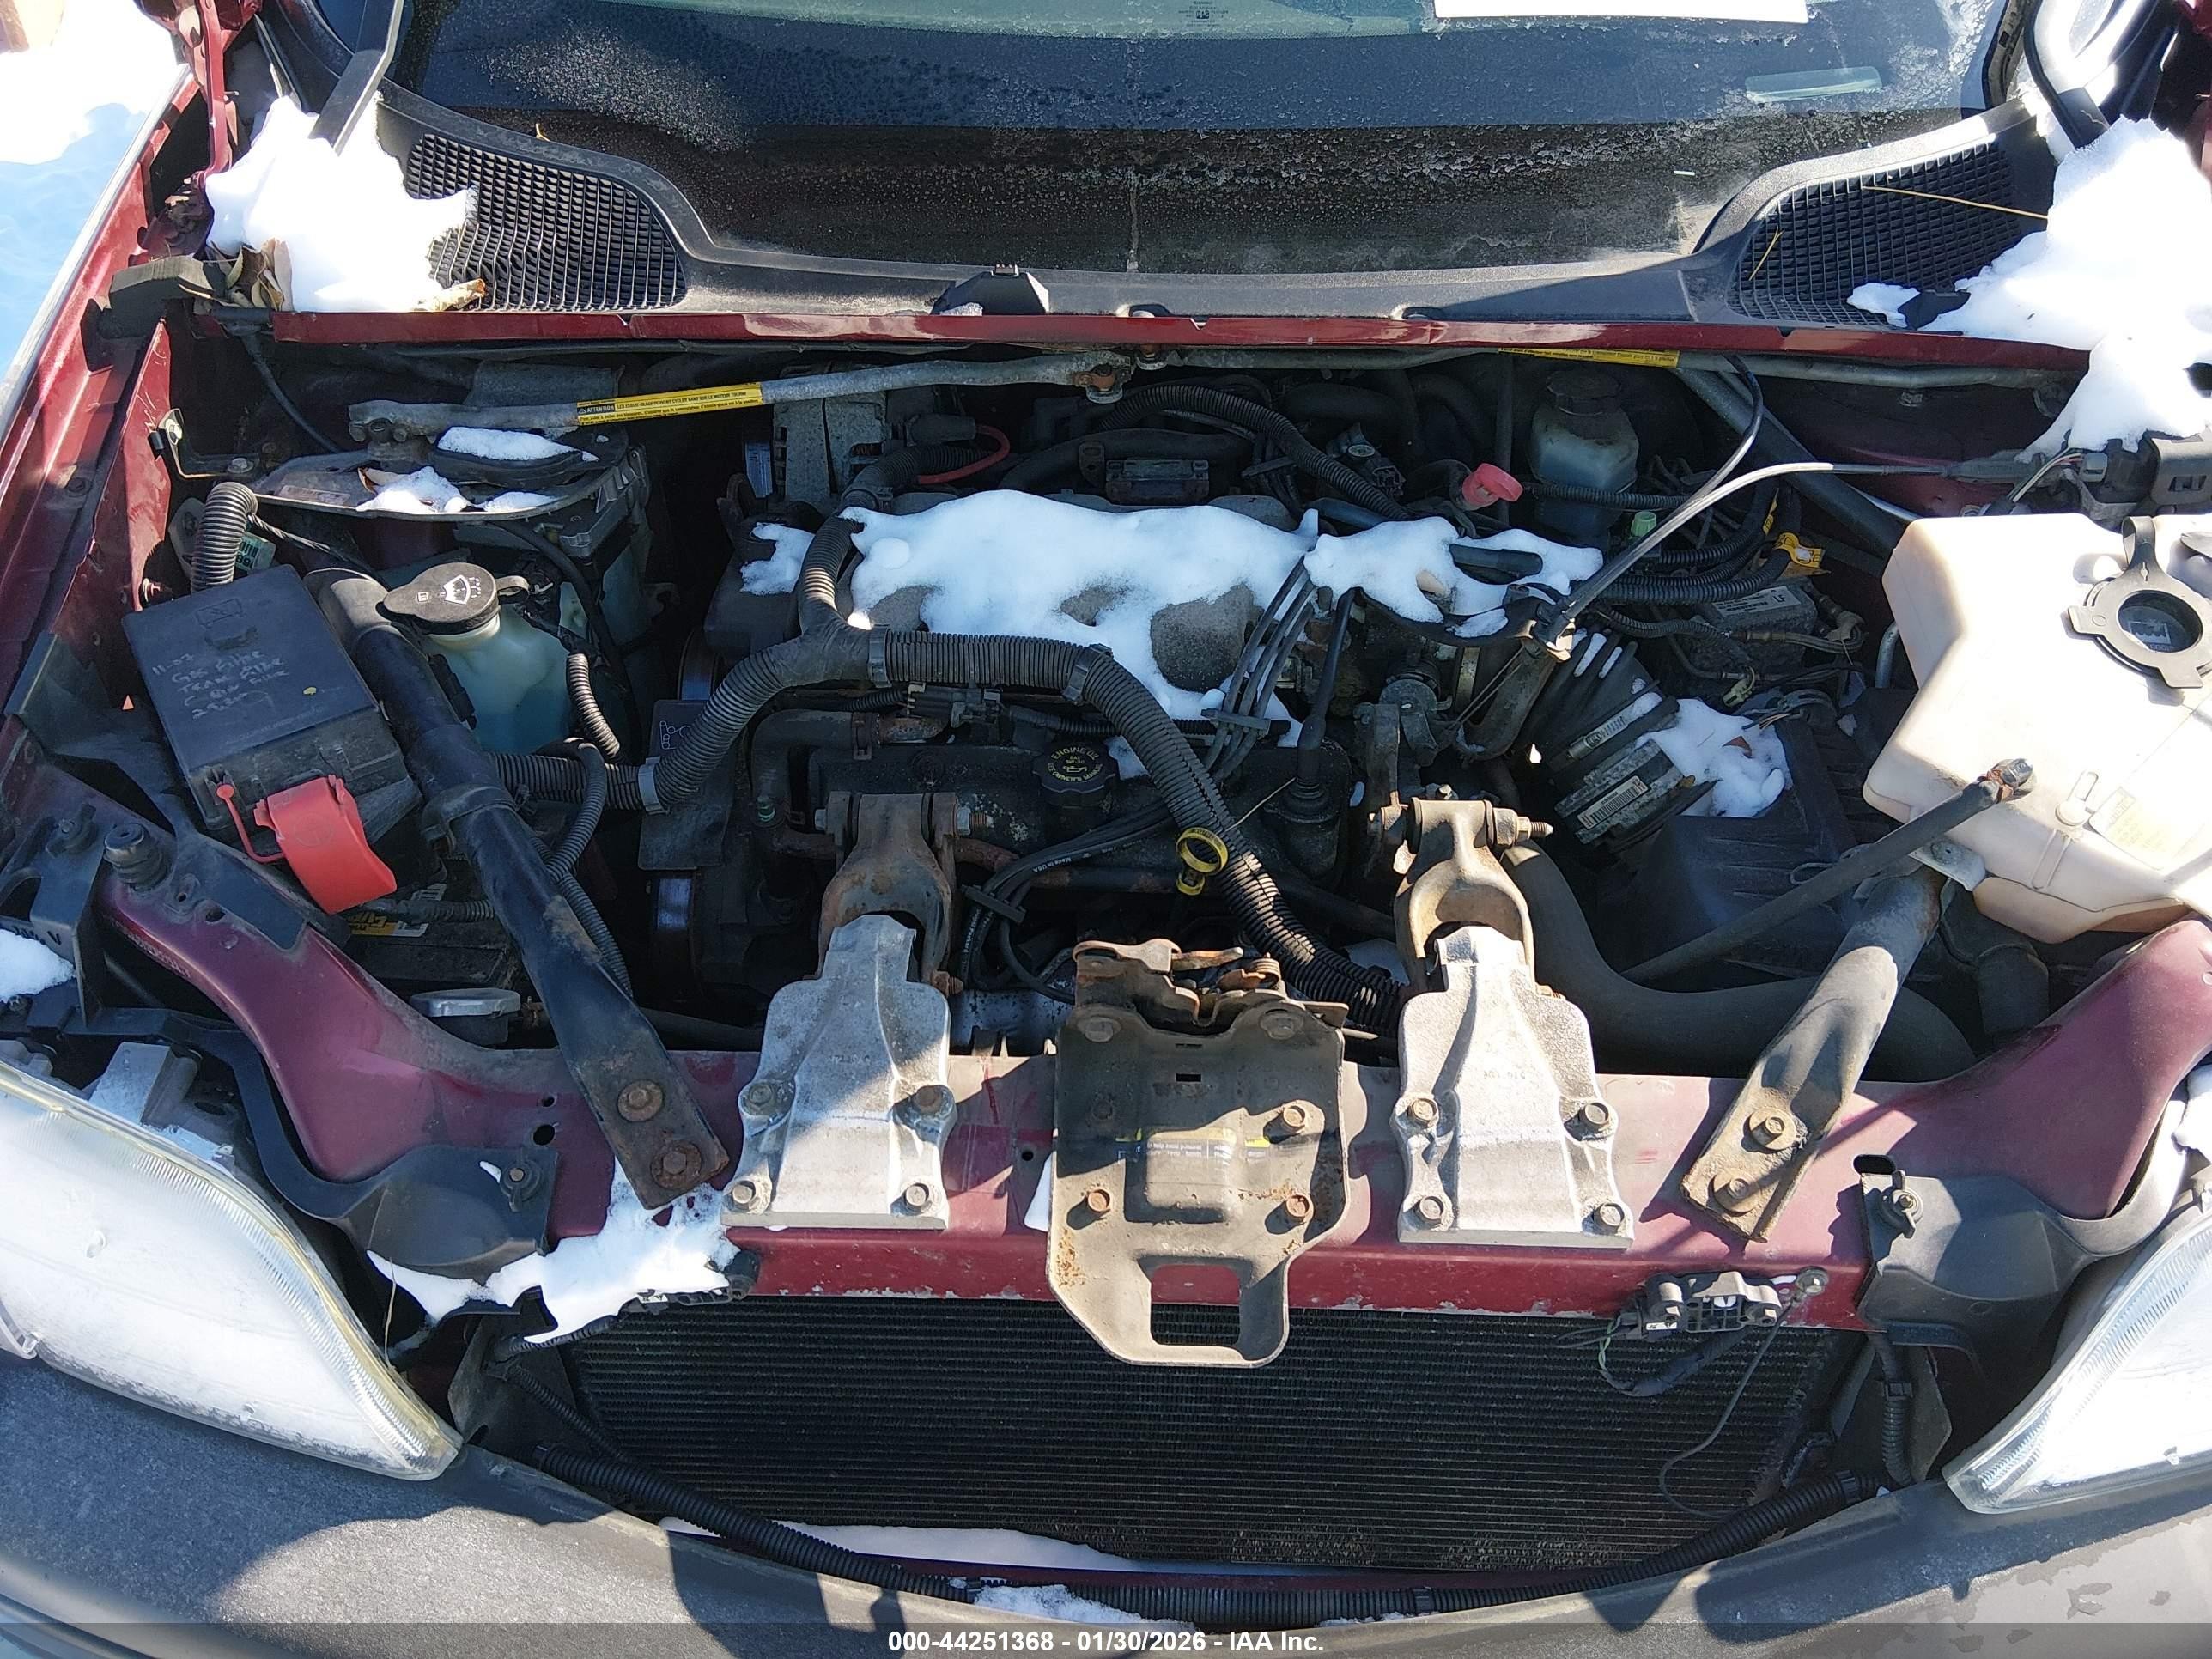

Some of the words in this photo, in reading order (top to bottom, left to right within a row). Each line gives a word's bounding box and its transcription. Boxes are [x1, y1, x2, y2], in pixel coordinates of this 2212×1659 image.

[586, 404, 616, 414] ATTENTION
[1051, 747, 1087, 760] ENGINE
[1032, 862, 1048, 873] USA
